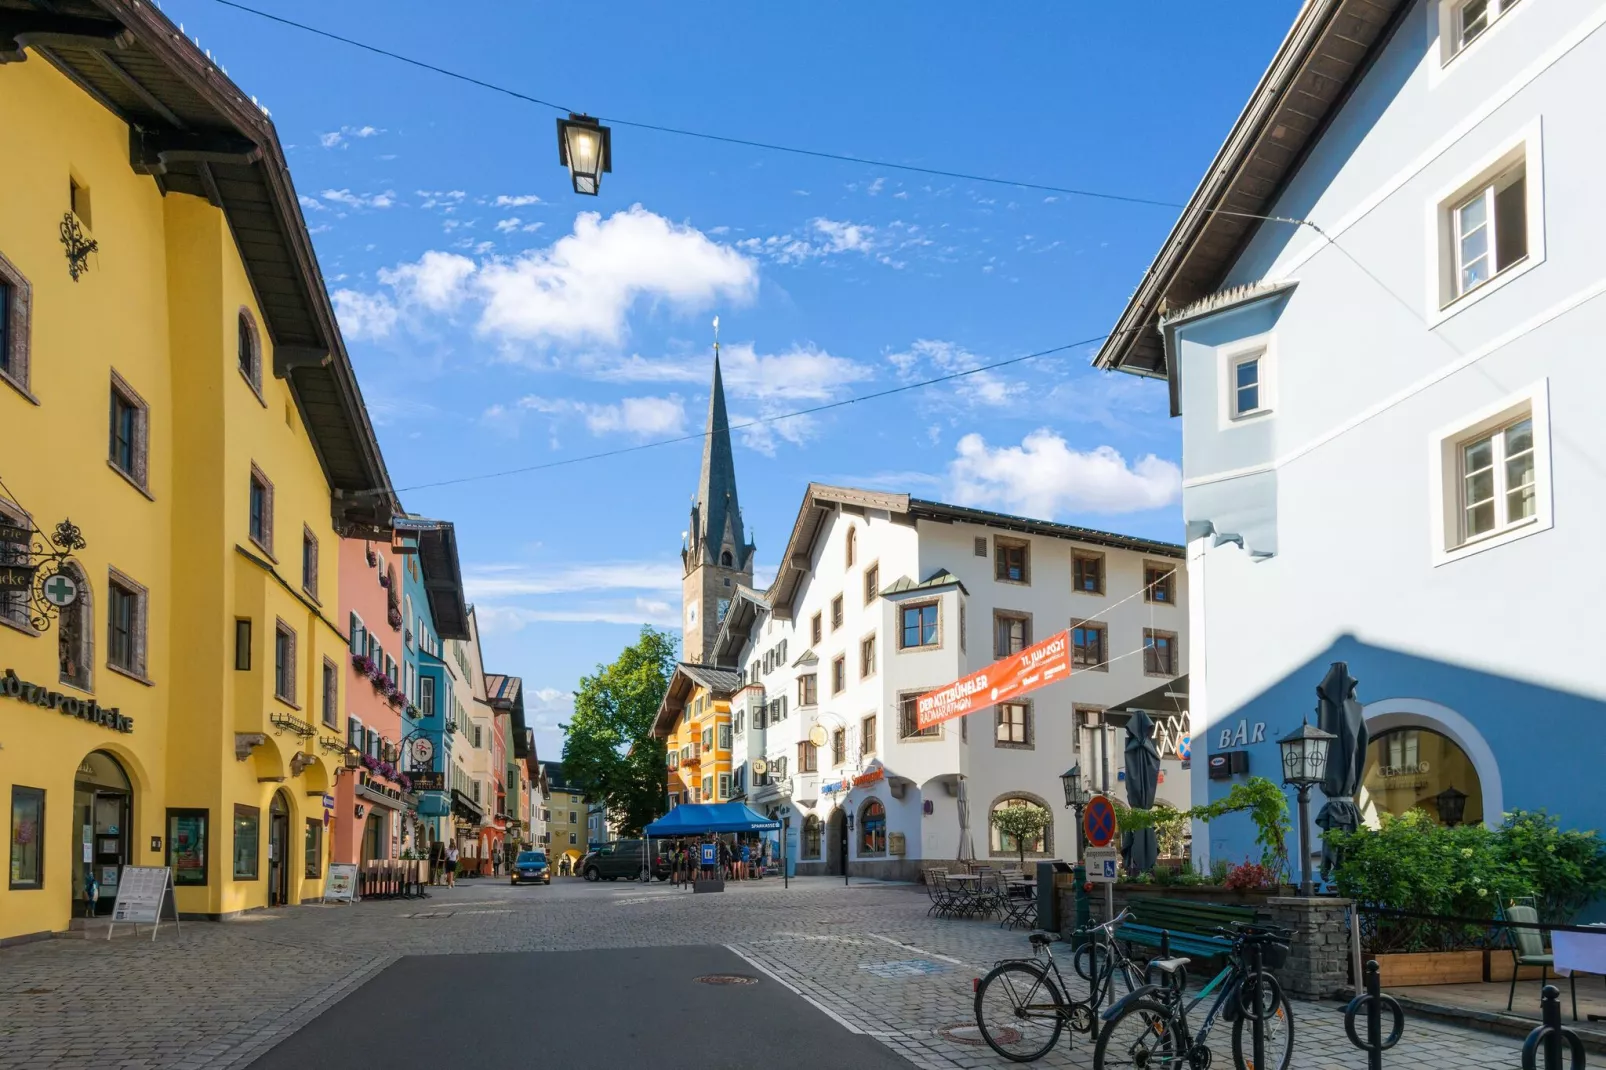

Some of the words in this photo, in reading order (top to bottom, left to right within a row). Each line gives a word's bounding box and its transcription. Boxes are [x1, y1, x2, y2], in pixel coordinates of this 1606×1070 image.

[1046, 639, 1064, 655] 2021
[919, 696, 933, 712] DER
[934, 675, 988, 706] KITZBÜHELER
[919, 697, 972, 725] RADMARATHON
[1217, 718, 1266, 750] BAR
